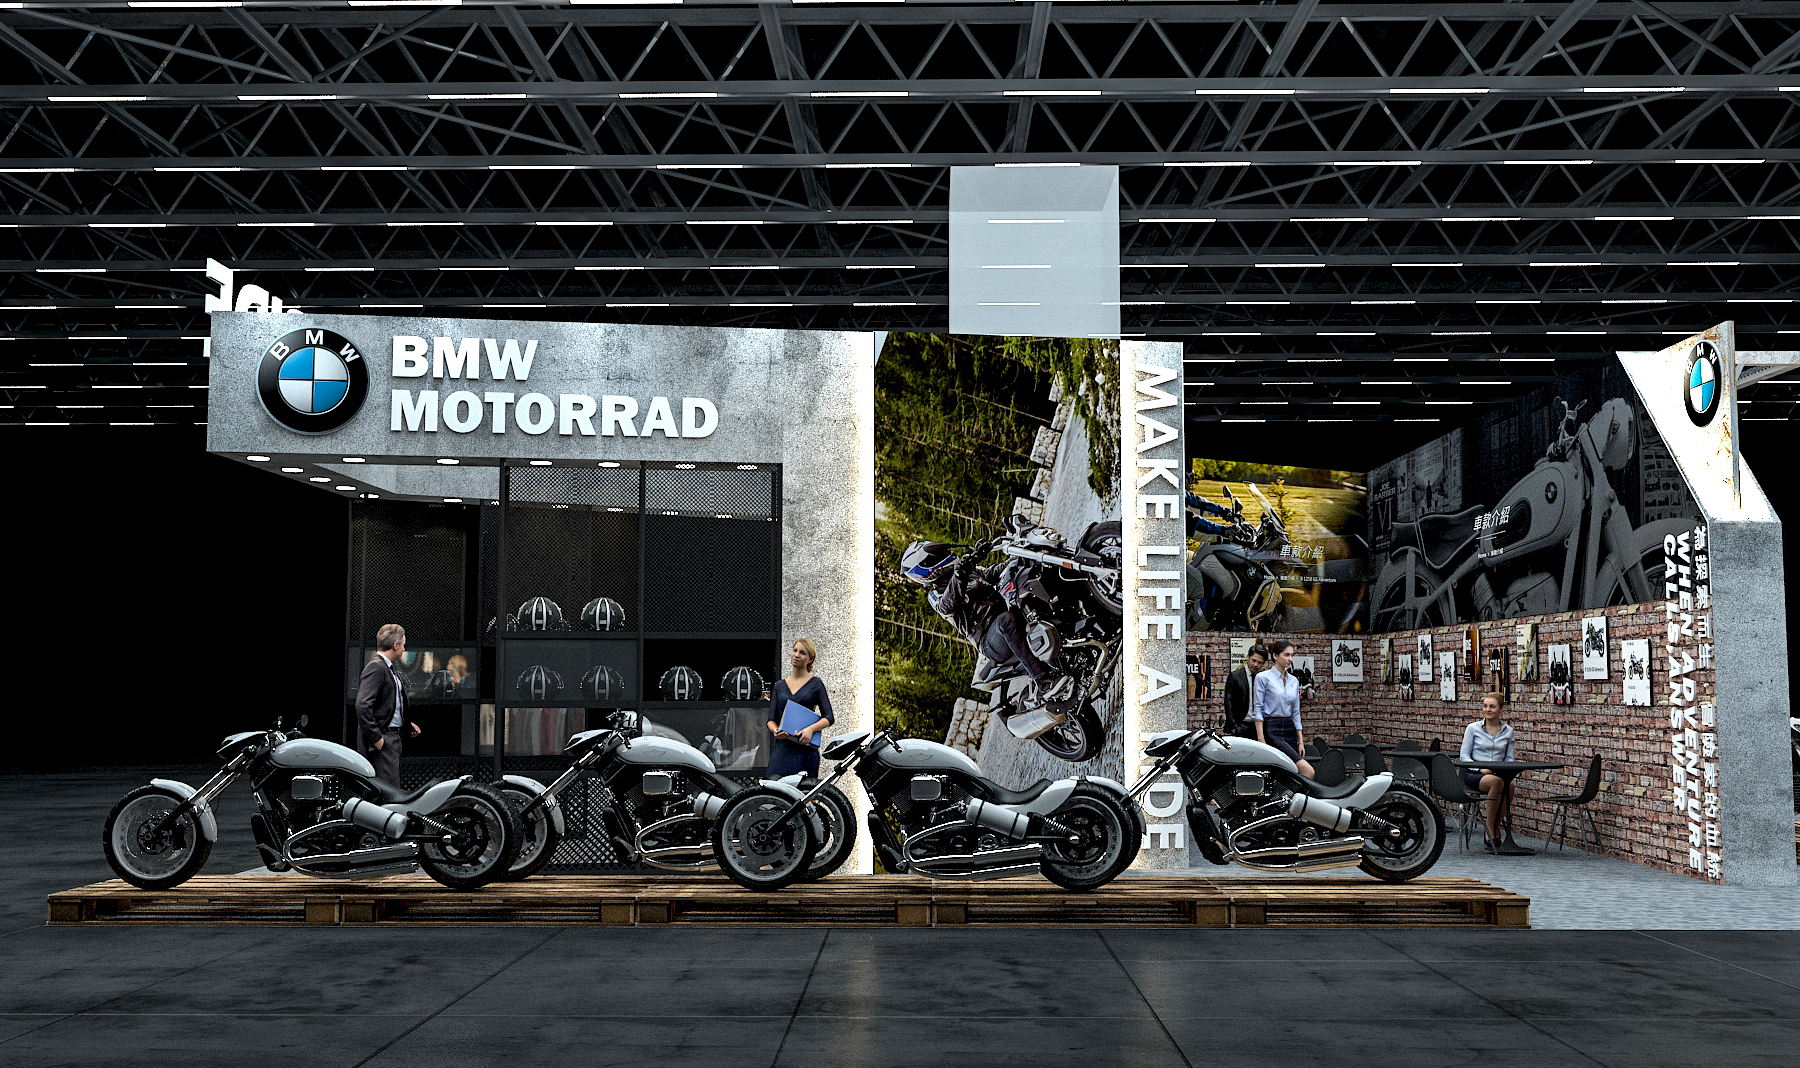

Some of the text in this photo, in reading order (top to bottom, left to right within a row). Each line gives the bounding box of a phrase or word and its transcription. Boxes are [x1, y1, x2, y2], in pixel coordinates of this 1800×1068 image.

[270, 330, 360, 362] BMW
[391, 335, 539, 382] BMW
[390, 389, 719, 439] MOTORRAD
[1135, 363, 1181, 519] MAKE
[1473, 506, 1511, 531] 車款介紹
[1280, 544, 1325, 559] 車款介紹
[1137, 545, 1182, 640] LIFE
[1139, 665, 1182, 706] A
[1186, 663, 1199, 674] YLE
[1676, 531, 1705, 873] WHEN ADVENTURE
